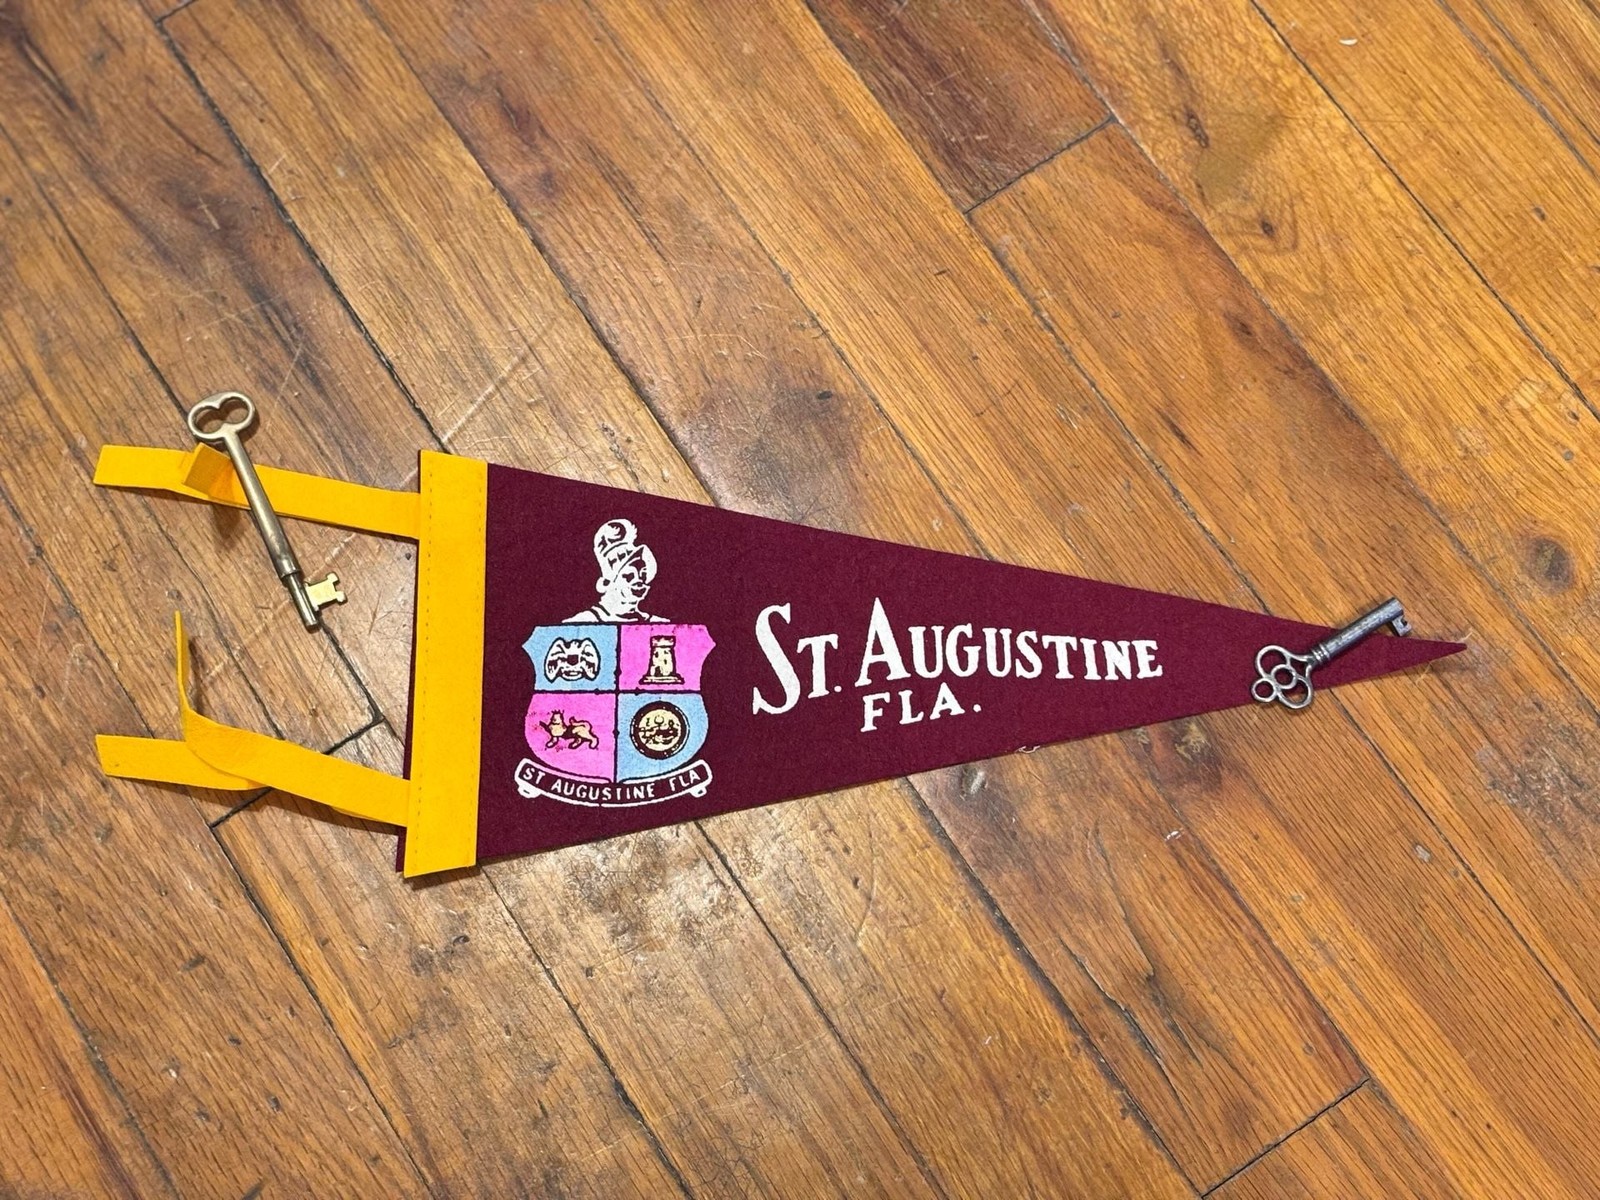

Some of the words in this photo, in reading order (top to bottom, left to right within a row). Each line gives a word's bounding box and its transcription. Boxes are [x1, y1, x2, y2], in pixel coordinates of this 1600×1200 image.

[752, 602, 843, 716] ST.
[854, 596, 1164, 688] AUGUSTINE
[860, 682, 982, 733] FLA.
[522, 767, 546, 785] ST
[551, 778, 655, 801] AUGUSTINE
[669, 769, 701, 792] FLA
